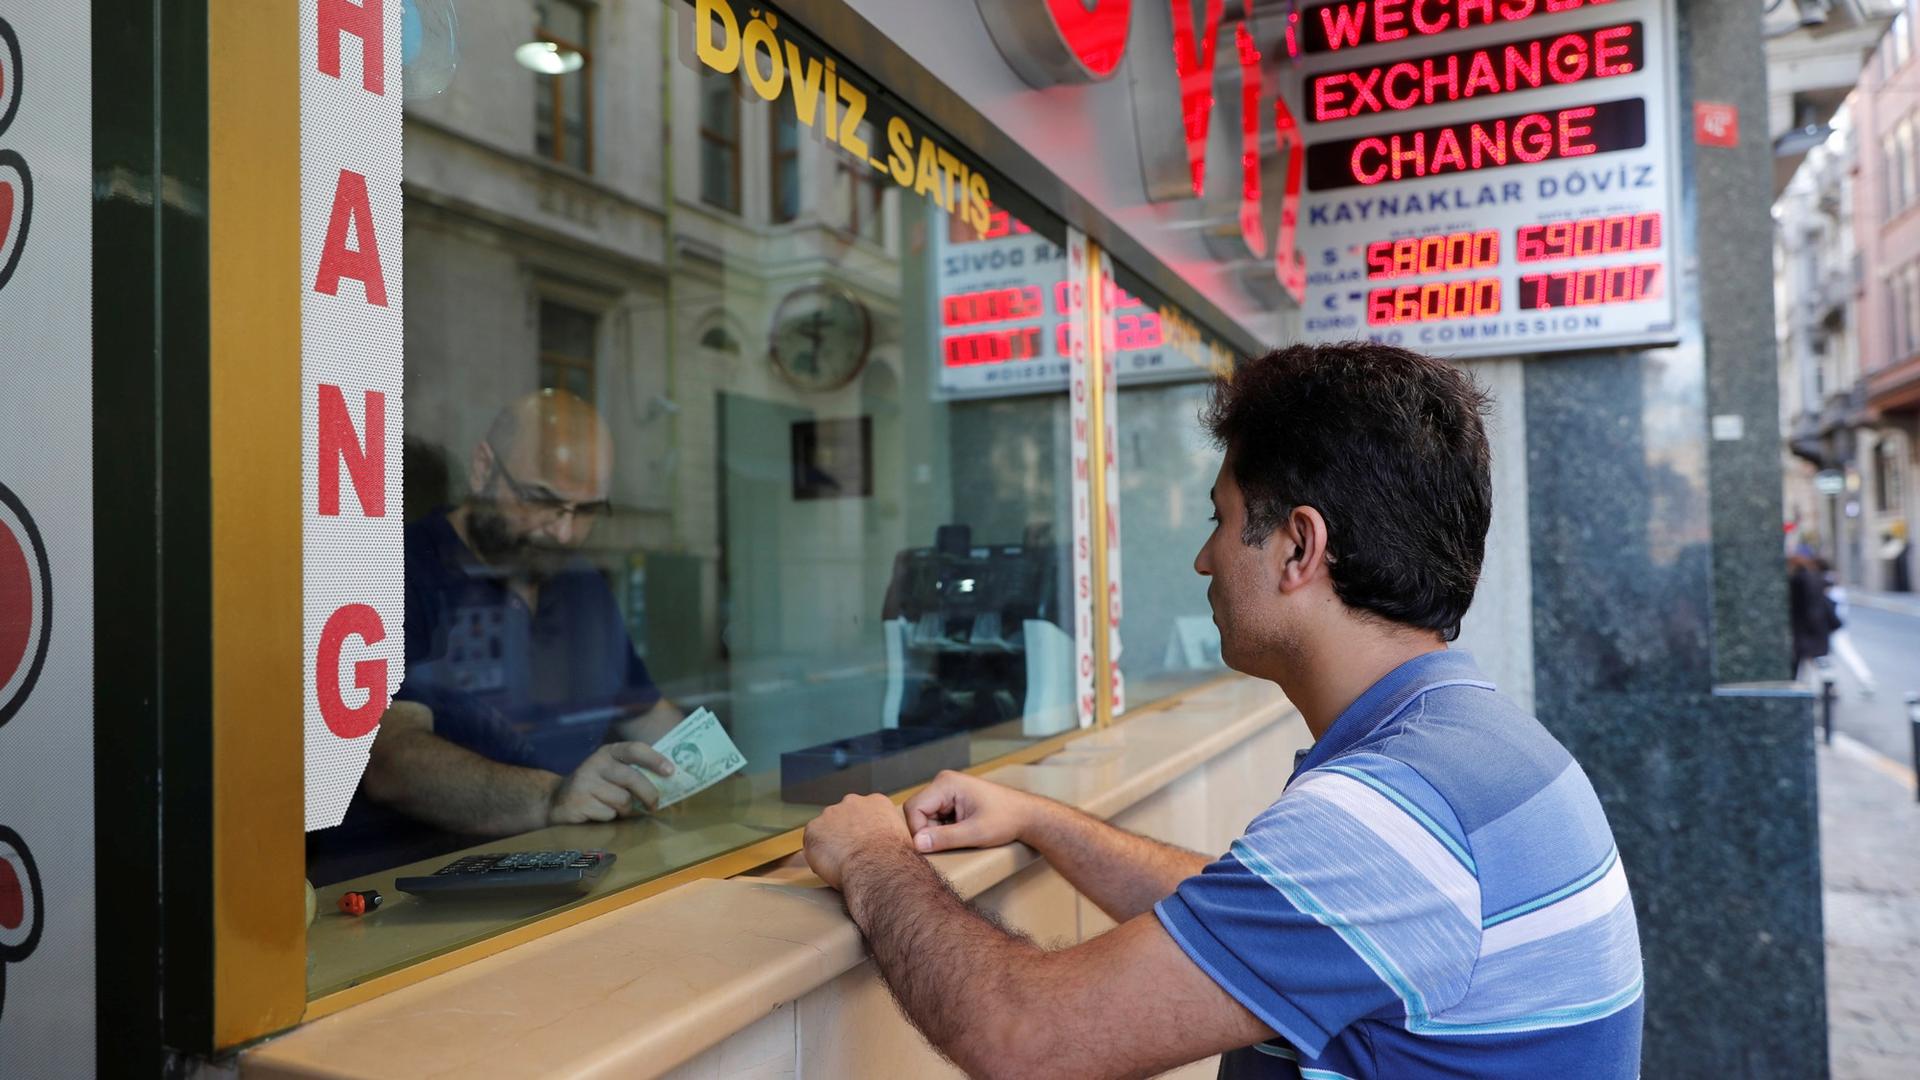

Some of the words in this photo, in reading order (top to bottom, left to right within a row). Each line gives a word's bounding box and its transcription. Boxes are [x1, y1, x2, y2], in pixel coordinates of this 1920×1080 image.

[1315, 26, 1633, 121] EXCHANGE
[1351, 107, 1596, 185] CHANGE
[1309, 181, 1523, 226] KAYNAKLAR
[1538, 164, 1655, 200] DÖVİZ
[1366, 229, 1500, 281] 58000
[1517, 212, 1662, 263] 69000
[1366, 277, 1501, 327] 66000
[1520, 262, 1663, 311] 77000
[1419, 315, 1602, 344] COMMISSION
